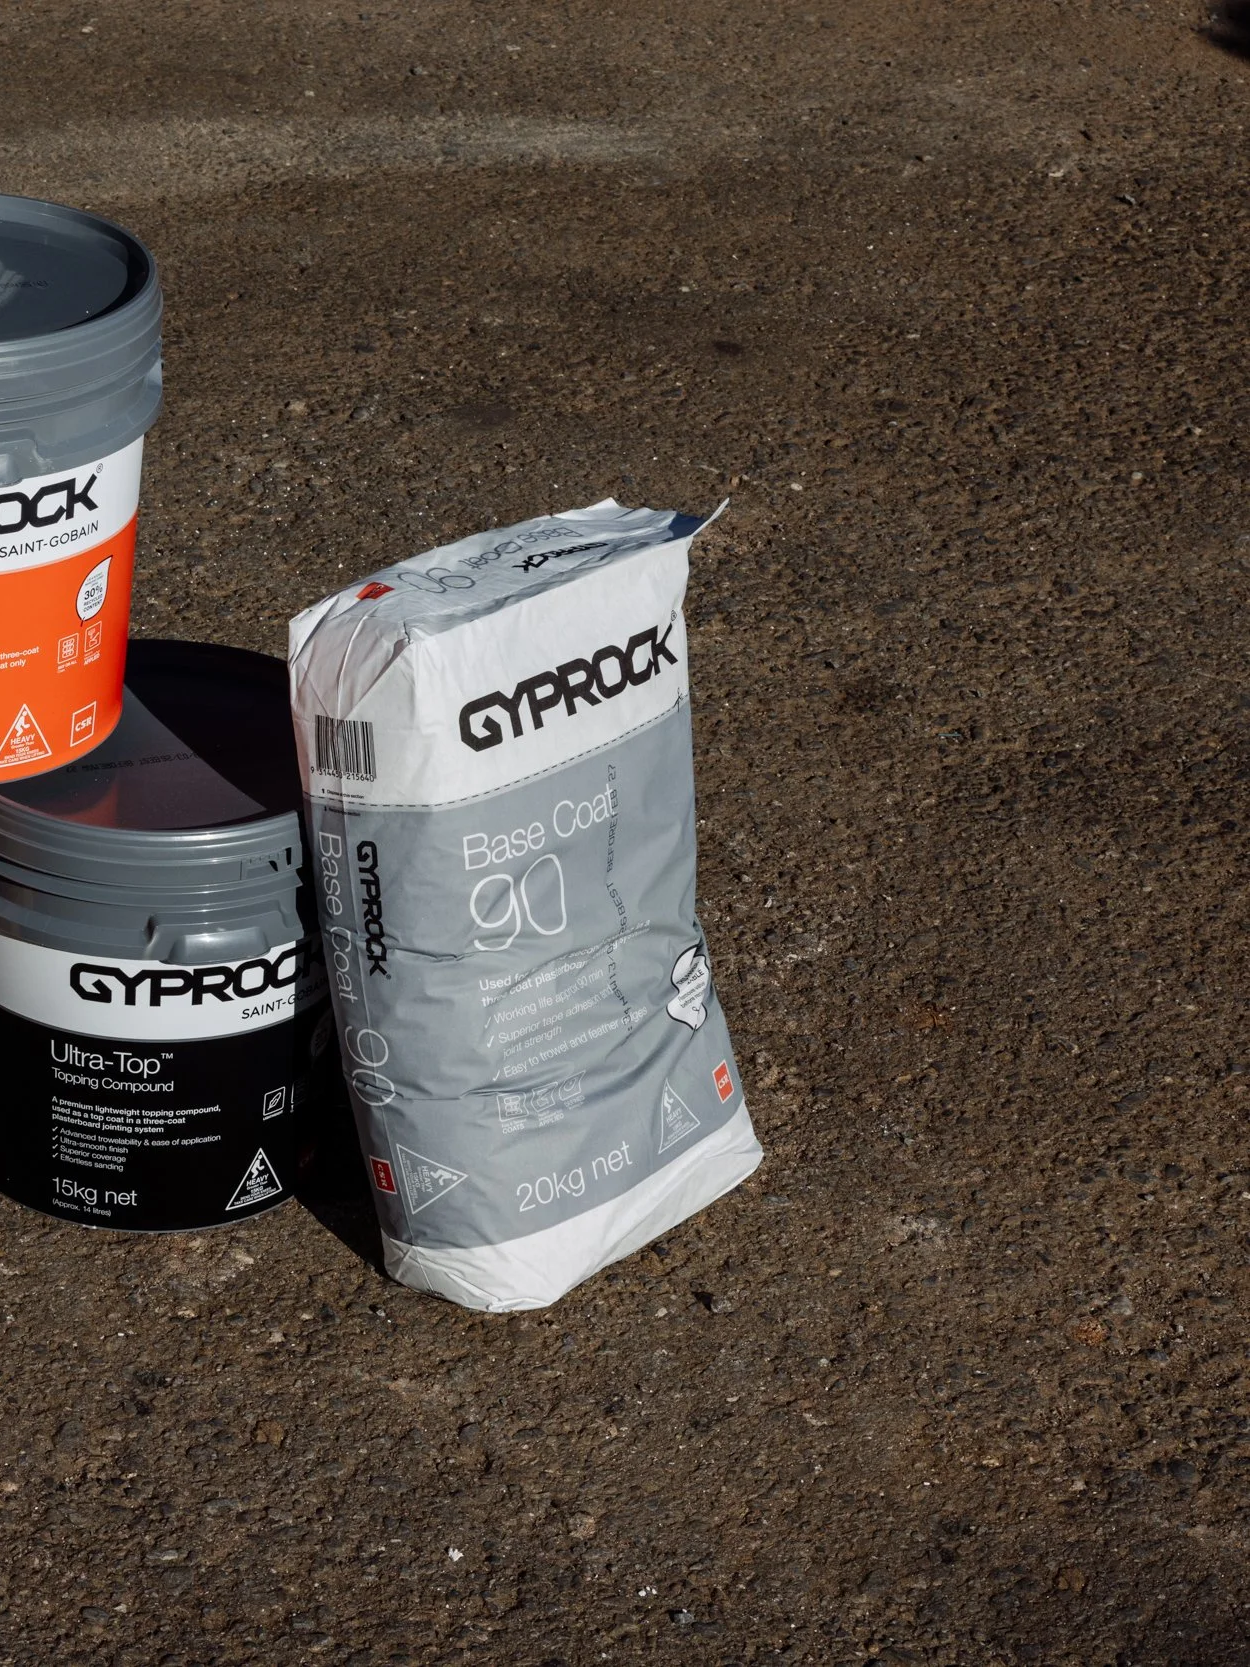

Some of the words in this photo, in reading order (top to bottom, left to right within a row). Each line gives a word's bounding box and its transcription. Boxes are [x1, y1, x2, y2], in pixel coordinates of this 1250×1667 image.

[0, 520, 99, 558] SAINT-GOBAIN
[84, 584, 103, 600] 30%
[0, 646, 40, 660] three-coat
[10, 659, 27, 668] only
[75, 716, 92, 732] CSR
[10, 734, 35, 745] HEAVY
[463, 822, 546, 871] Base
[553, 783, 615, 837] Coat
[318, 831, 343, 916] Base
[470, 854, 567, 951] 90
[330, 926, 358, 1003] Coat
[479, 976, 511, 991] Used
[509, 980, 532, 995] coat
[494, 1003, 537, 1025] Working
[498, 1023, 541, 1044] Superior
[543, 1011, 564, 1028] tape
[524, 1026, 562, 1048] strength
[503, 1060, 528, 1078] Easy
[540, 1042, 569, 1062] trowel
[570, 1034, 588, 1048] and
[588, 1019, 619, 1040] feather
[345, 1025, 396, 1106] 90
[52, 1067, 98, 1089] Topping
[102, 1078, 174, 1093] Compound
[718, 1074, 729, 1089] CSR
[52, 1105, 70, 1114] used
[90, 1112, 104, 1121] top
[143, 1117, 186, 1125] three-coat
[59, 1099, 93, 1111] premium
[95, 1105, 140, 1116] lightweight
[142, 1109, 174, 1118] topping
[175, 1104, 221, 1116] compound,
[52, 1113, 100, 1129] plasterboard
[102, 1123, 132, 1133] jointing
[134, 1126, 164, 1134] system
[60, 1128, 96, 1141] Advanced
[98, 1135, 142, 1147] trowelability
[181, 1135, 221, 1146] application
[60, 1136, 107, 1151] Ultra-smooth
[60, 1145, 90, 1157] Superior
[91, 1153, 126, 1163] coverage
[60, 1153, 92, 1167] Effortless
[94, 1162, 123, 1172] sanding
[246, 1174, 269, 1186] HEAVY
[422, 1165, 434, 1193] HEAVY
[516, 1167, 585, 1212] 20kg
[592, 1140, 633, 1181] net
[52, 1177, 97, 1205] 15kg
[105, 1190, 137, 1206] net
[52, 1198, 80, 1211] (Approx.
[93, 1207, 111, 1217] litres)
